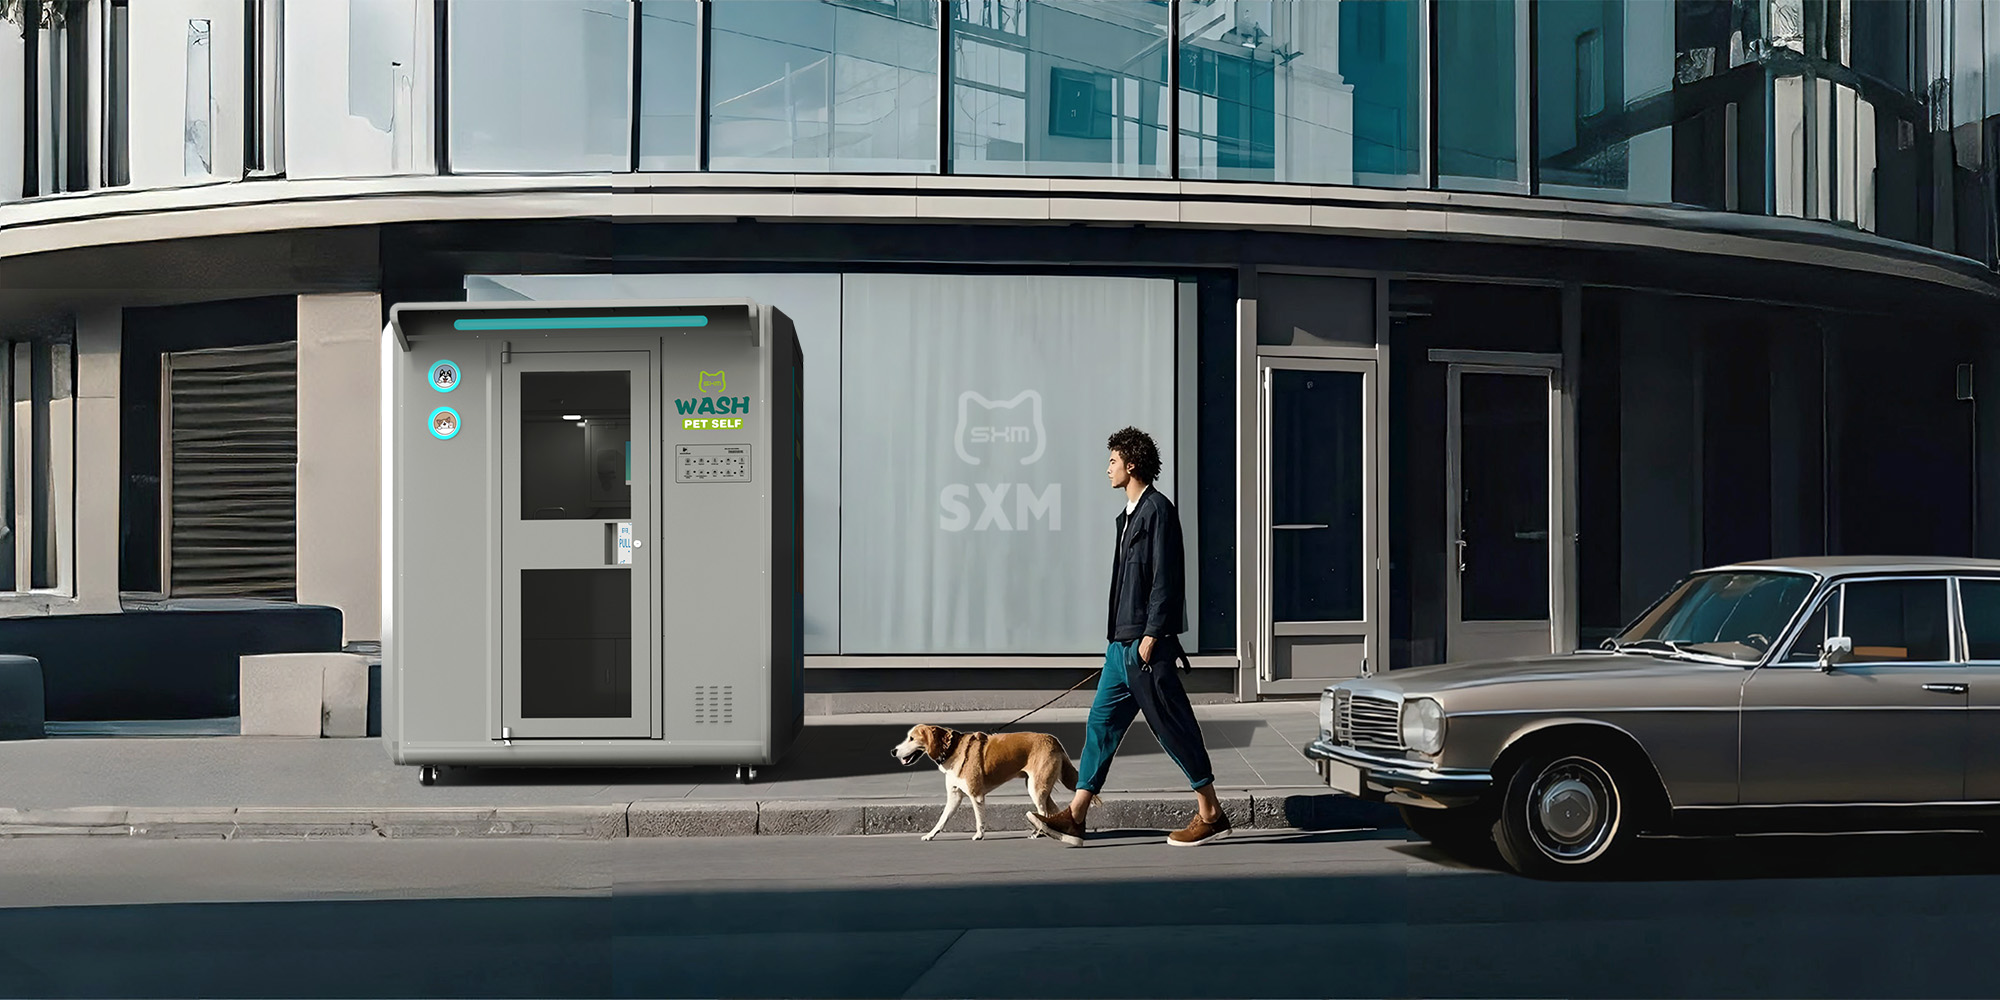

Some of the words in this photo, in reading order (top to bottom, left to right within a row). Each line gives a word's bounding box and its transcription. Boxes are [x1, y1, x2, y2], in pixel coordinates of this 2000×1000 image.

[674, 396, 750, 415] WASH
[684, 419, 708, 429] PET
[711, 419, 742, 429] SELF
[939, 483, 1062, 532] SXM
[619, 538, 631, 548] PULL
